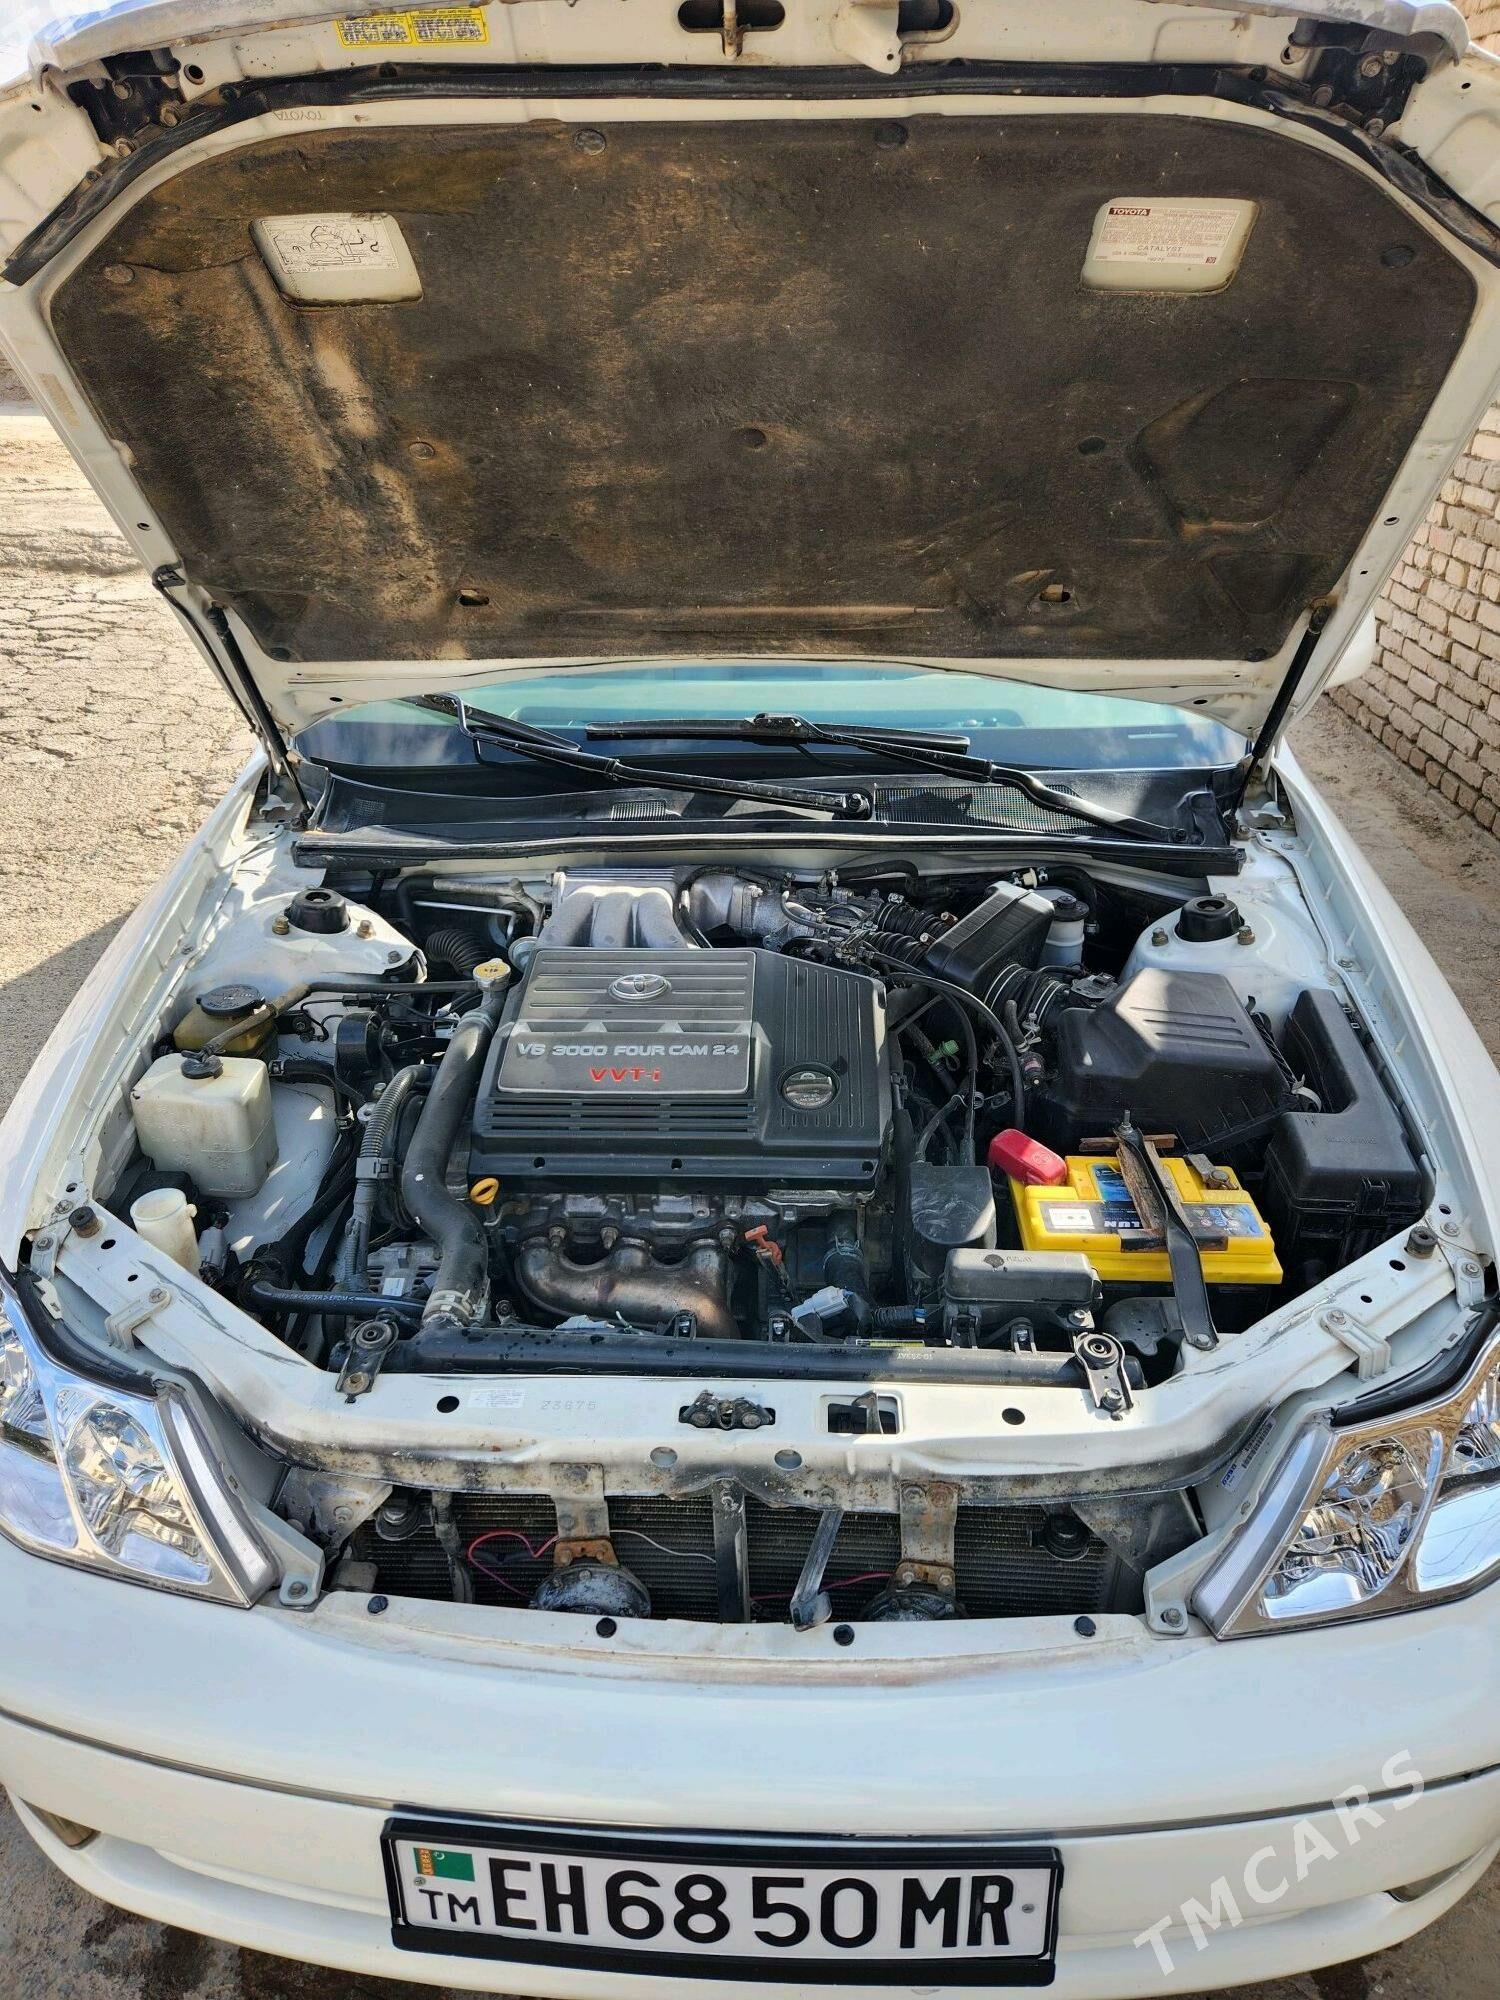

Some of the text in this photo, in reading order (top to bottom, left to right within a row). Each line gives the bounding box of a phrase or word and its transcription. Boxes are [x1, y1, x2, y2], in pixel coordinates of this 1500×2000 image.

[1112, 208, 1148, 216] TOYOTA
[517, 1043, 740, 1056] V6 3000 FOUR CAM 24
[588, 1066, 663, 1082] VVT-i
[418, 1888, 482, 1926] TM
